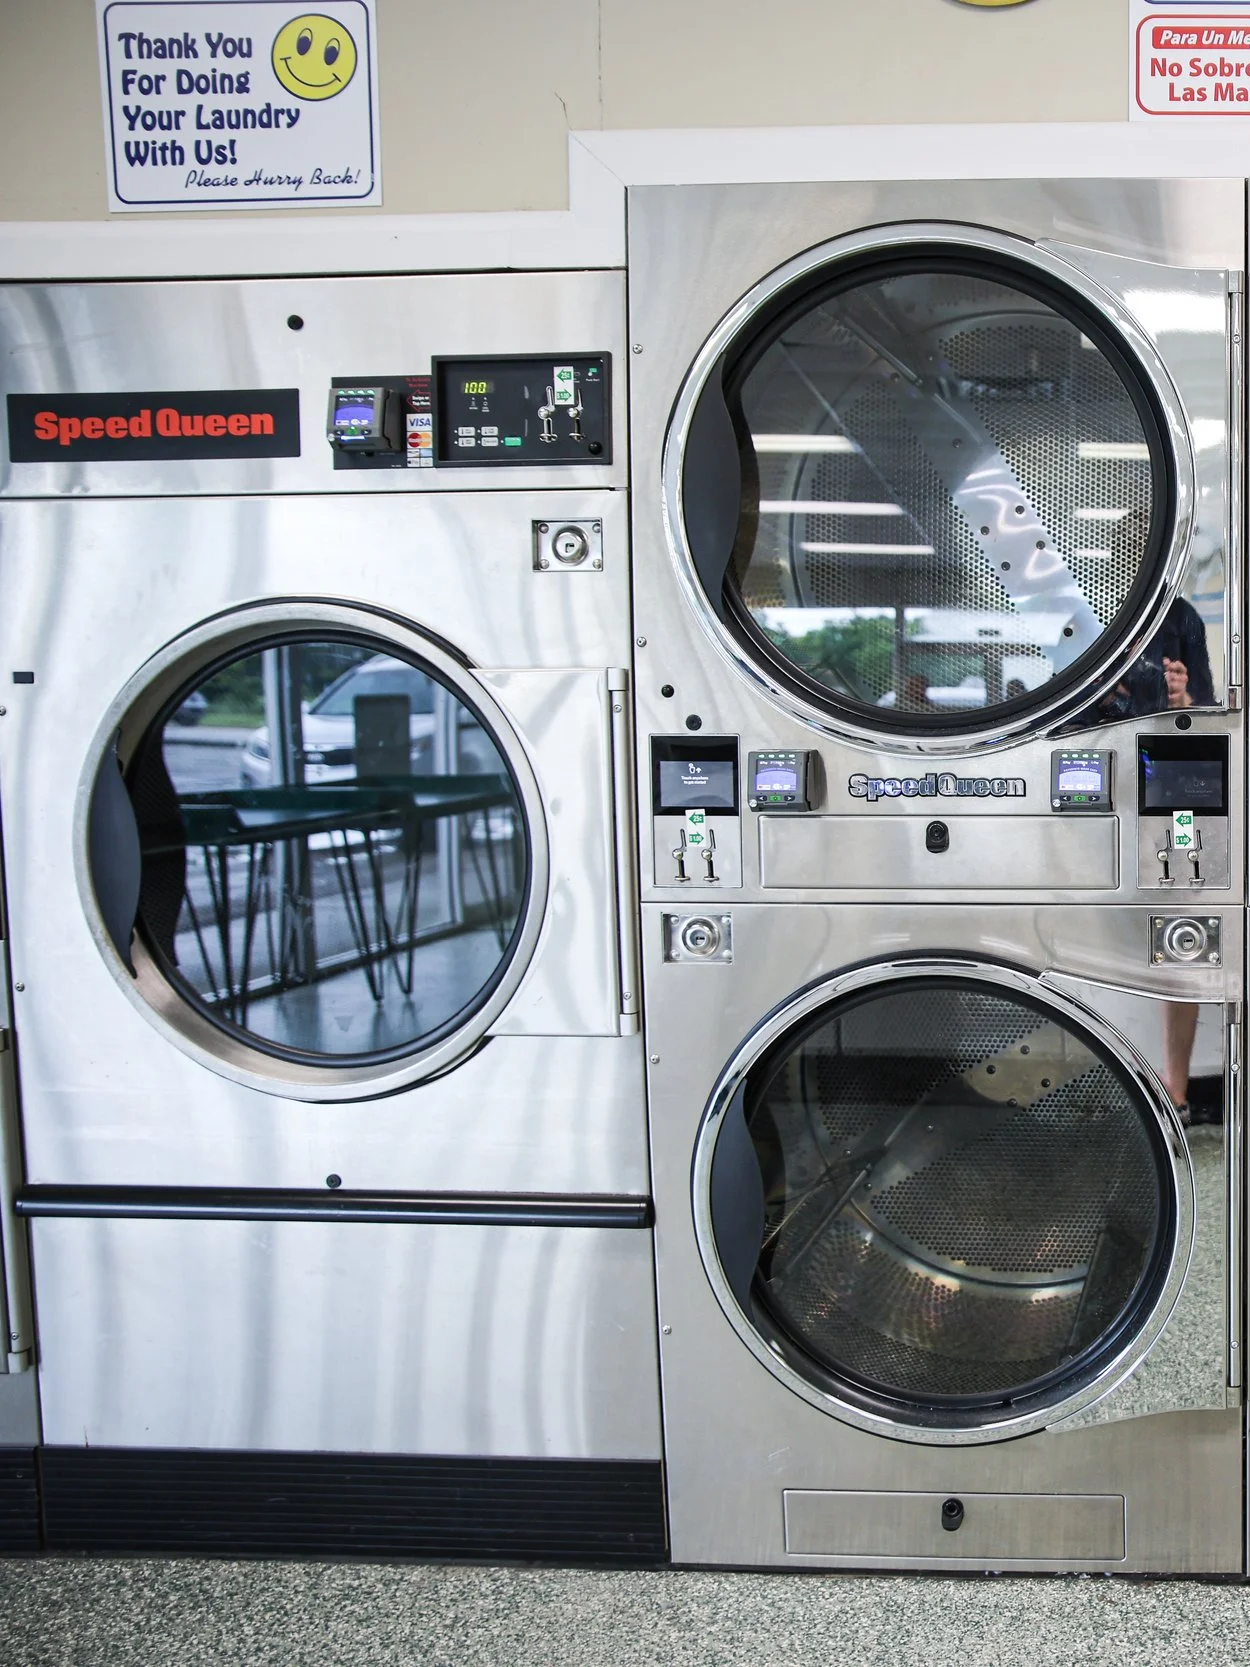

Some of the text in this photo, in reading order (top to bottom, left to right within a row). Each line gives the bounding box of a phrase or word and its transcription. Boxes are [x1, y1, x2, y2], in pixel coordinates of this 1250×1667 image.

[118, 32, 253, 59] Thank You
[1160, 30, 1197, 45] Para
[1201, 30, 1225, 45] Un
[1150, 57, 1183, 77] No
[121, 68, 251, 95] For Doing
[1168, 82, 1207, 102] Las
[122, 102, 301, 131] Your Laundry
[124, 139, 238, 167] With Us!
[185, 166, 362, 191] Please Hurry Back!
[463, 382, 487, 394] 100
[34, 408, 275, 446] Speed Queen
[409, 418, 431, 427] VISA
[849, 773, 1026, 801] Speed Queen
